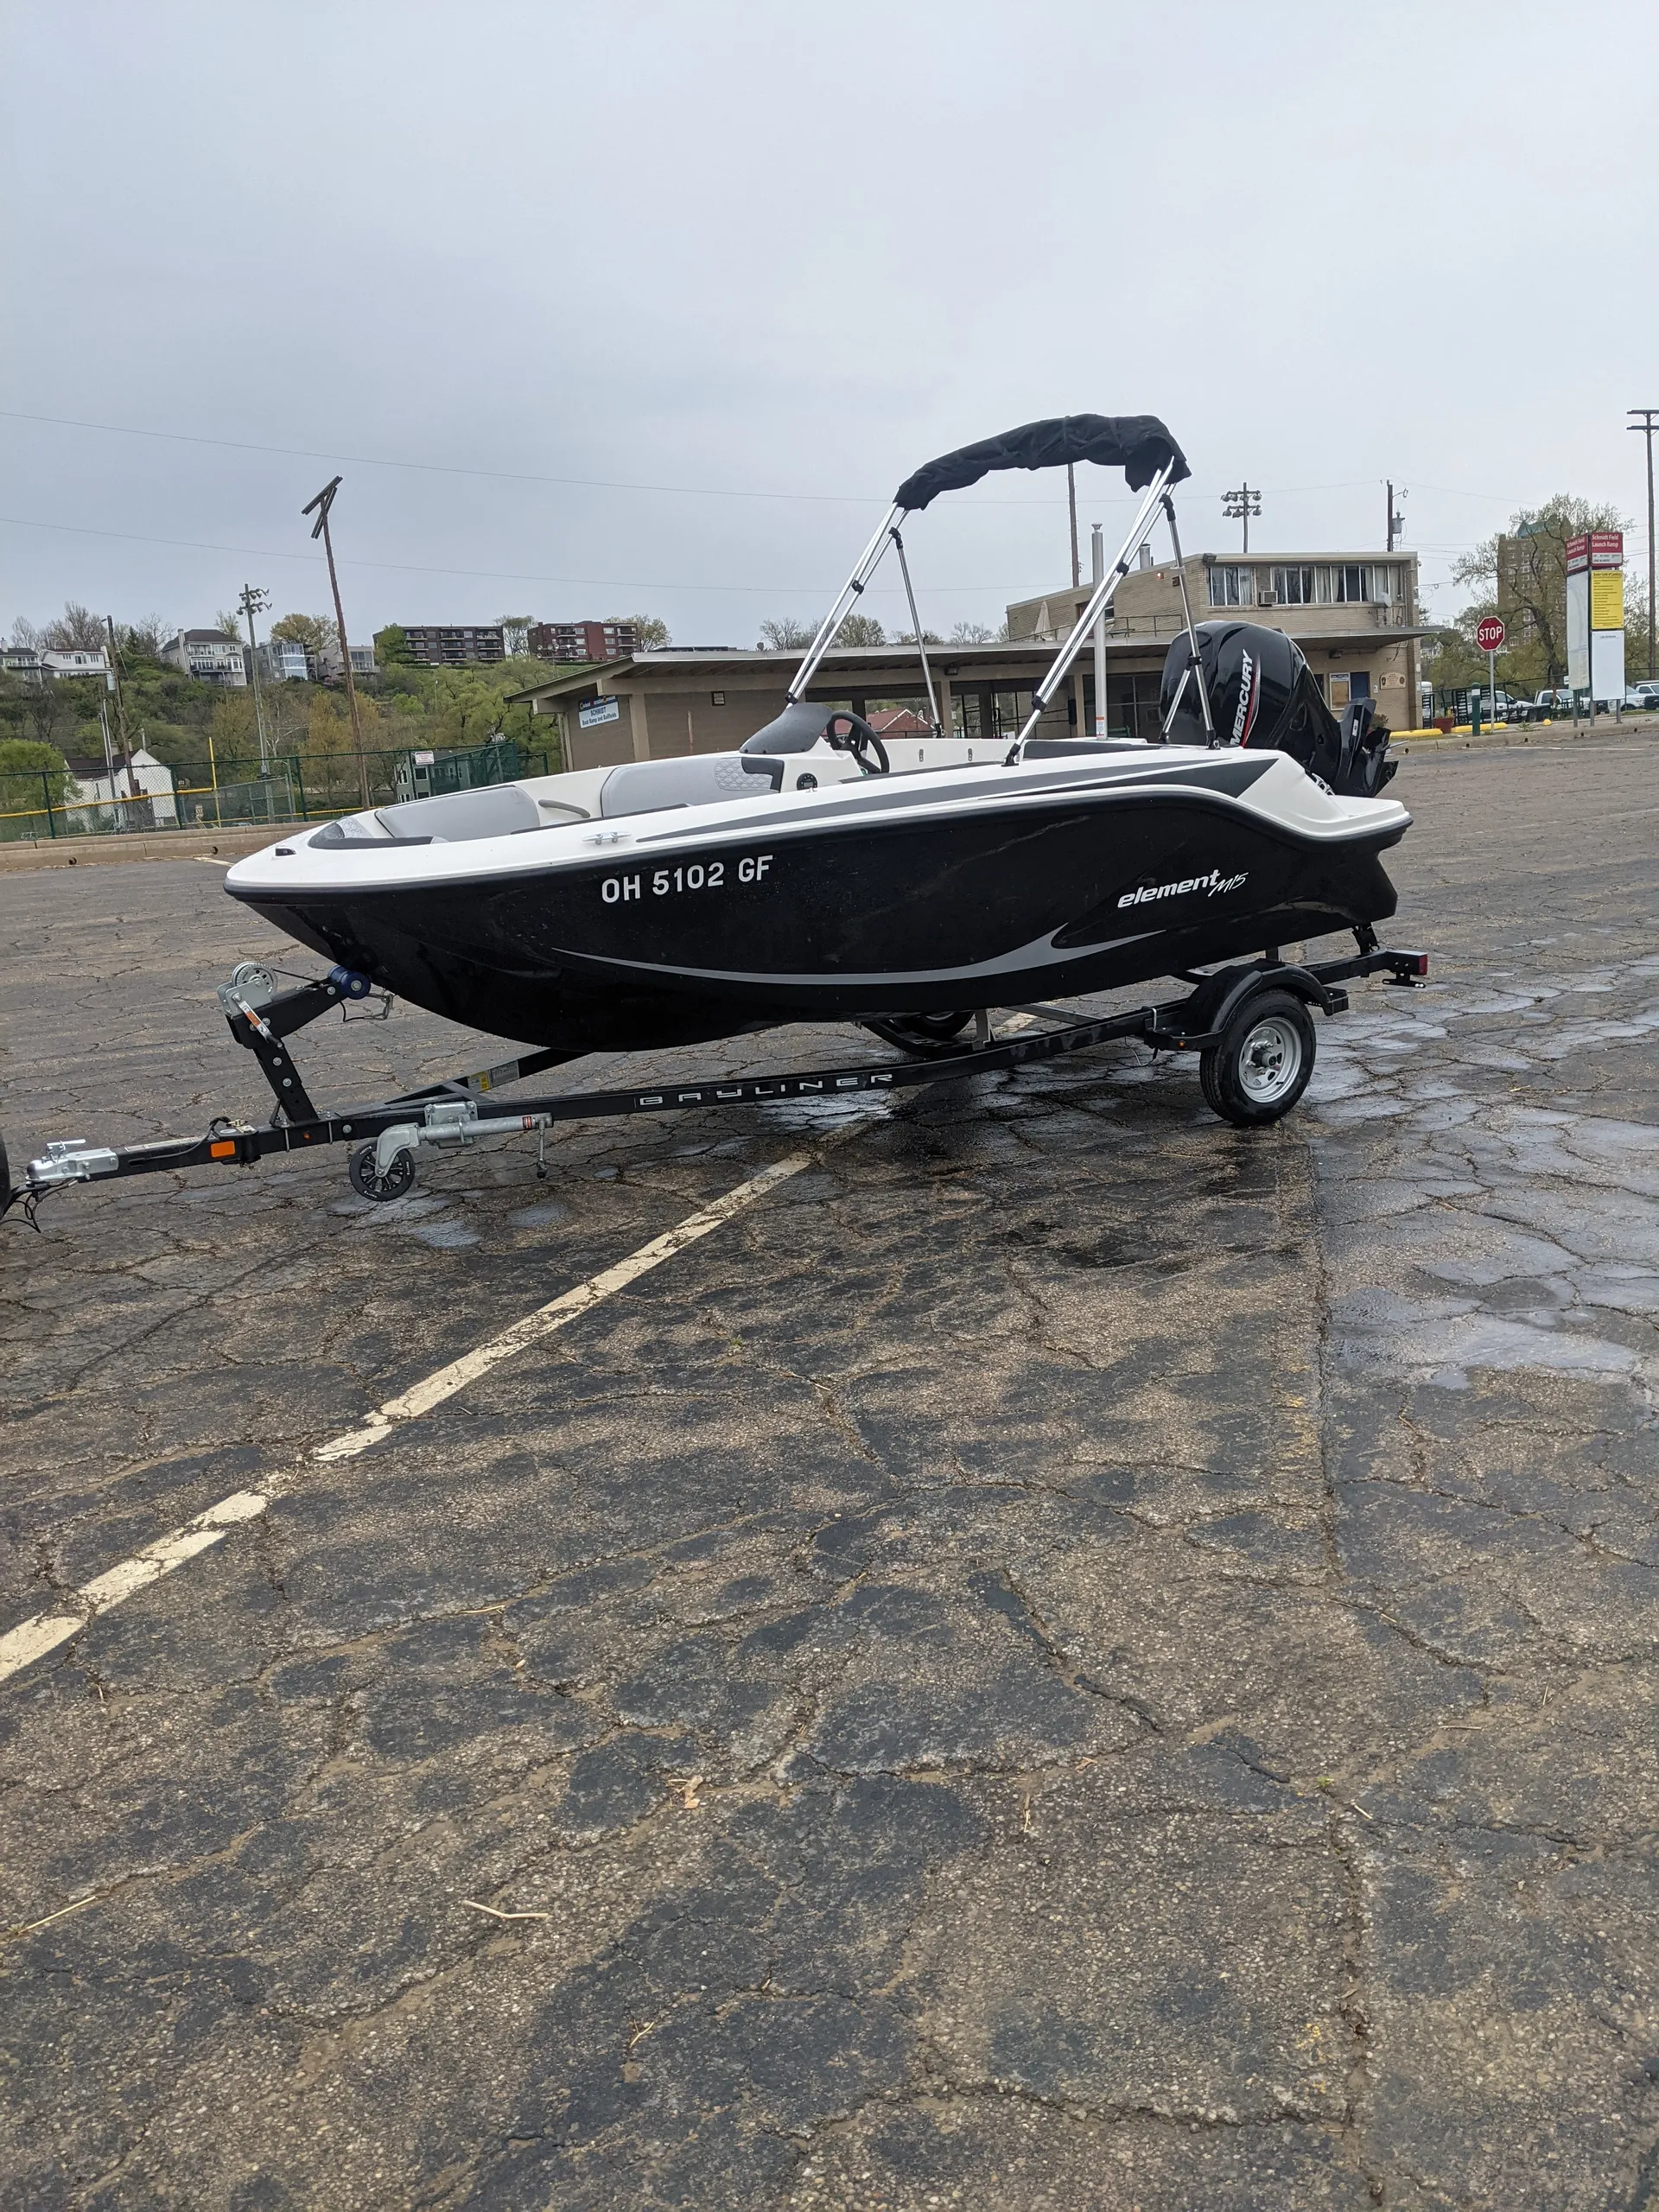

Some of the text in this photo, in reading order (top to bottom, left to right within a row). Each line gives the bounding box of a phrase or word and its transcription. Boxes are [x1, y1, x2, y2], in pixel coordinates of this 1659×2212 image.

[1478, 626, 1503, 641] STOP
[1230, 648, 1253, 746] MERCURY
[601, 855, 773, 903] OH 5102 GF
[1117, 869, 1249, 908] element M15
[639, 1073, 893, 1106] BAYLINER
